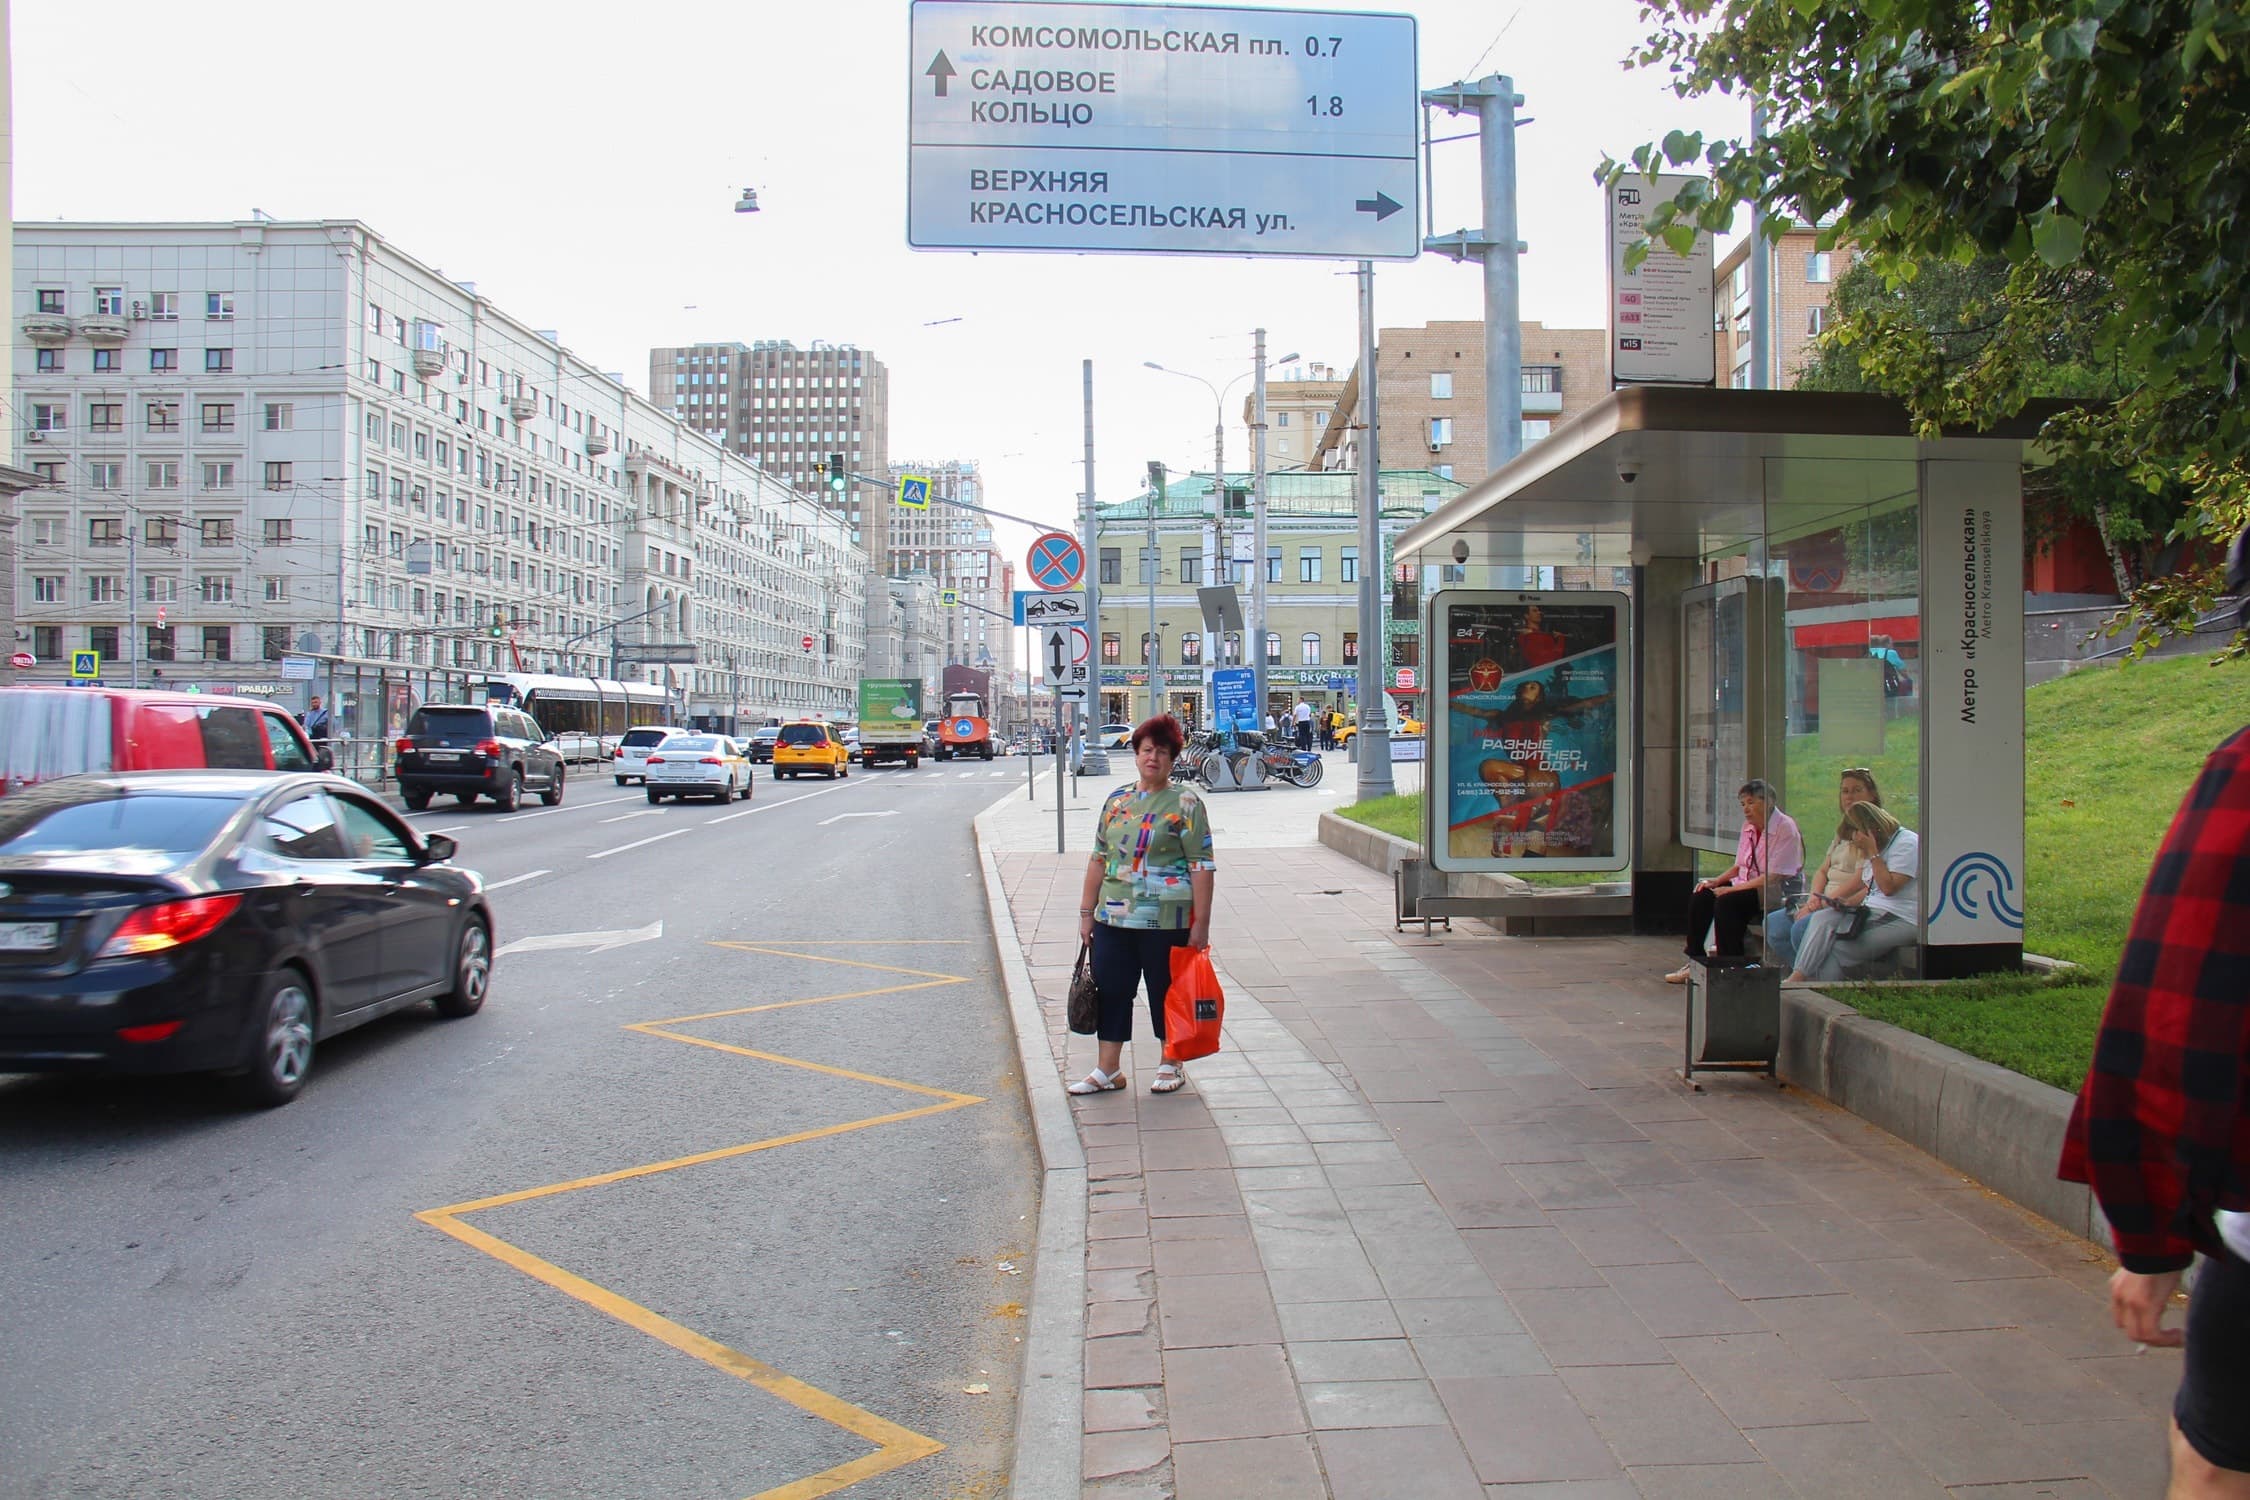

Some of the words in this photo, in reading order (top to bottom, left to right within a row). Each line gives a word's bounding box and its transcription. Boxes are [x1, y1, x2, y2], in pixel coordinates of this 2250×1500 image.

[971, 25, 1239, 55] КОМСОМОЛЬСКАЯ
[1249, 38, 1290, 56] пл.
[1304, 35, 1343, 58] 0.7
[970, 69, 1116, 95] САДОВОЕ
[970, 101, 1093, 128] КОЛЬЦО
[1306, 96, 1344, 117] 1.8
[970, 168, 1109, 194] ВЕРХНЯЯ
[970, 201, 1246, 230] КРАСНОСЕЛЬСКАЯ
[1255, 212, 1296, 235] ул.
[1980, 510, 1992, 600] Krasnoselskaya
[1961, 508, 1979, 660] «Красносельская»
[1980, 602, 1992, 639] Metro
[237, 685, 275, 696] ПРАВДА
[1961, 668, 1979, 724] Метро
[1482, 739, 1553, 750] РАЗНЫЕ
[1510, 750, 1582, 760] ФИТНЕС
[1539, 760, 1588, 772] ОДИН
